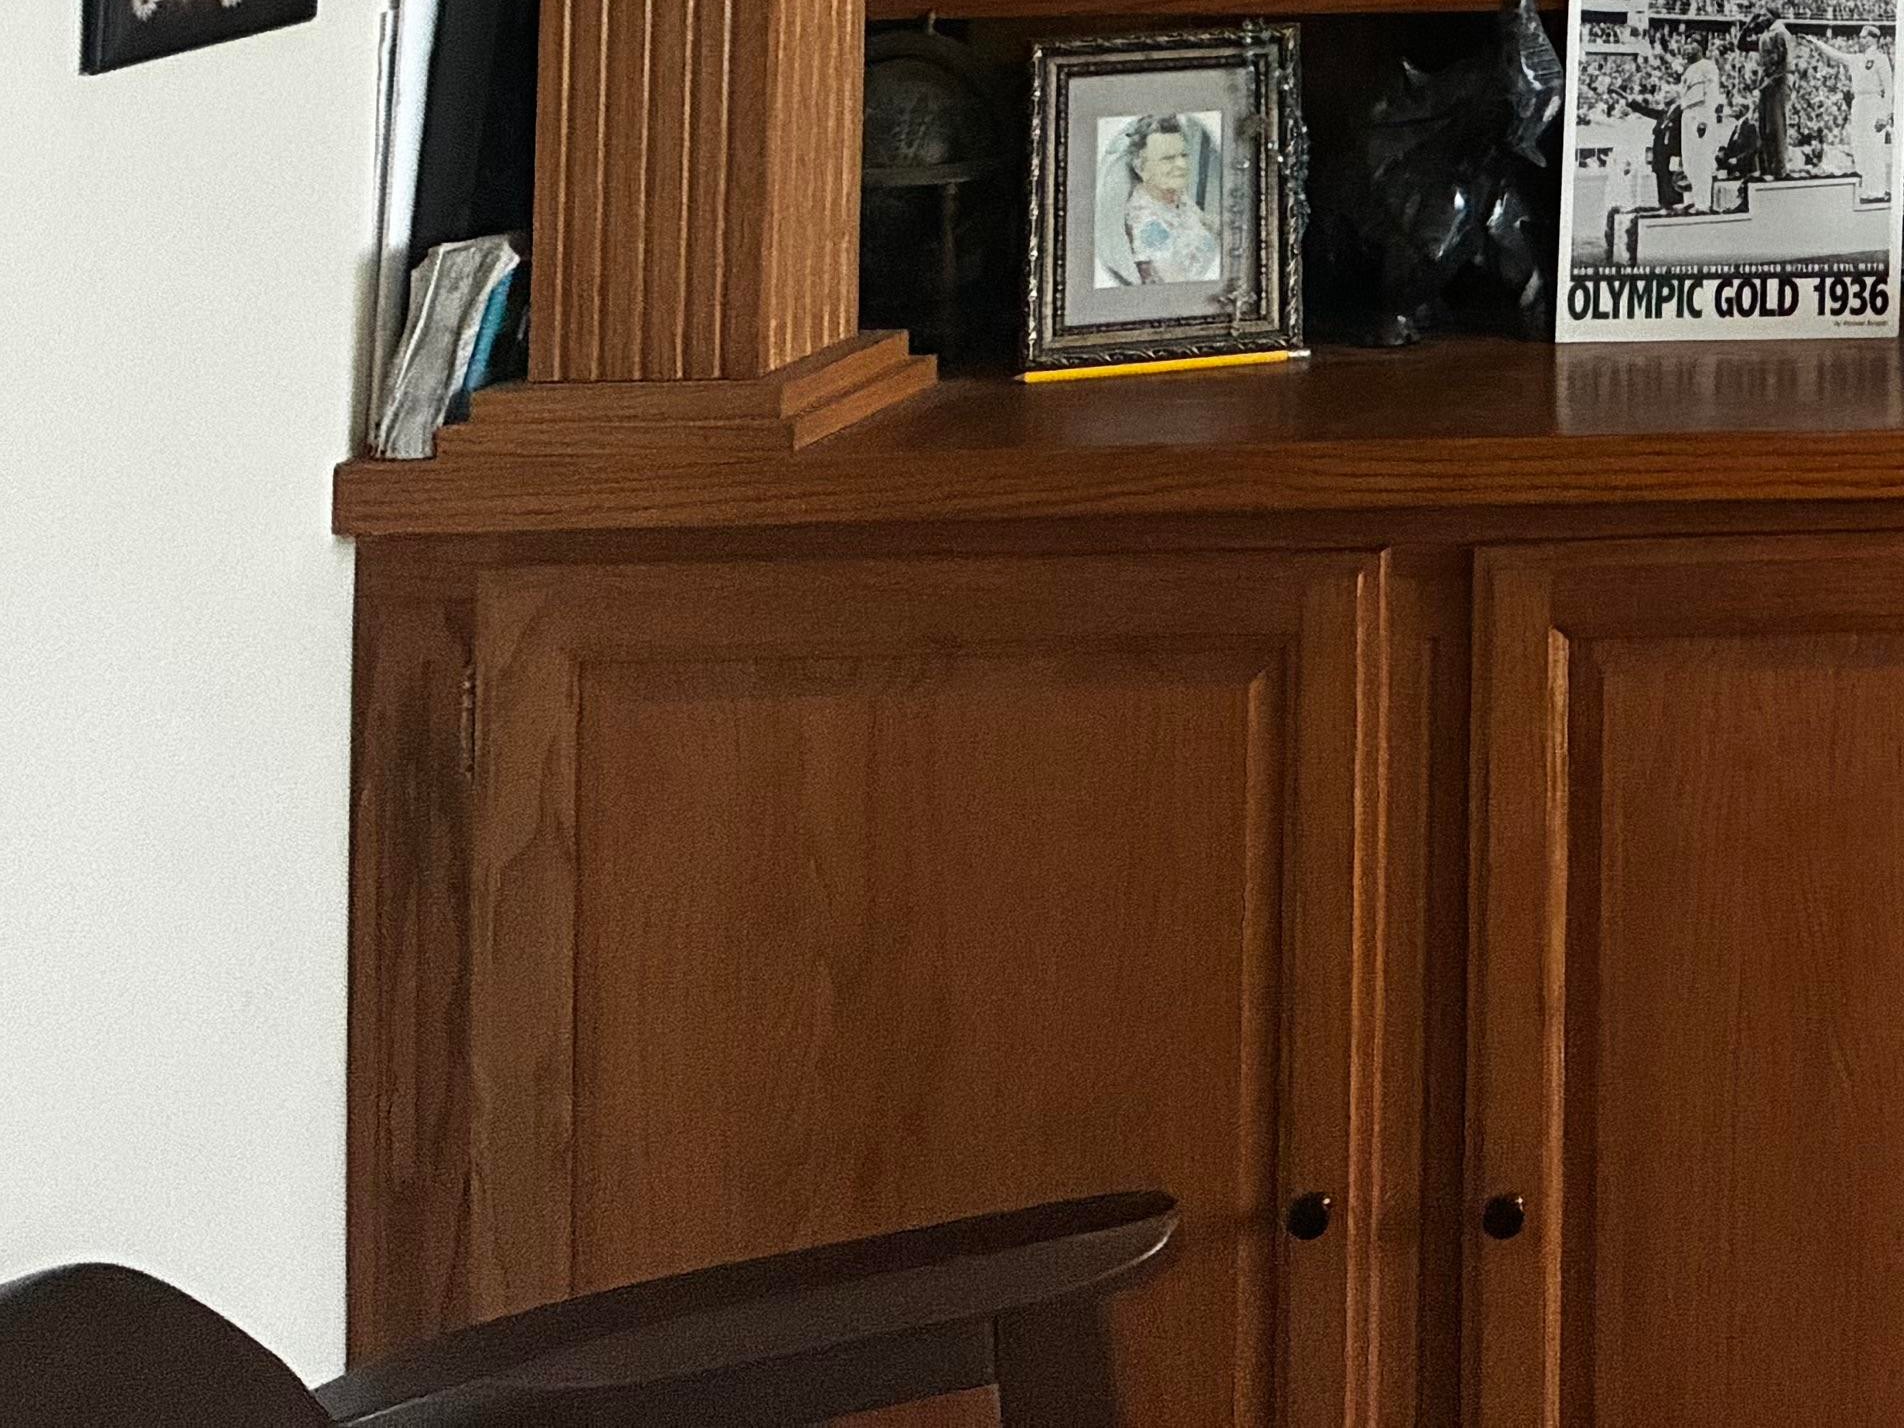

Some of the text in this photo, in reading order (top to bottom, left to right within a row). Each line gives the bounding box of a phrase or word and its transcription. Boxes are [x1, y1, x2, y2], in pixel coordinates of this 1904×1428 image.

[1567, 276, 1890, 320] OLYMPIC GOLD 1936
